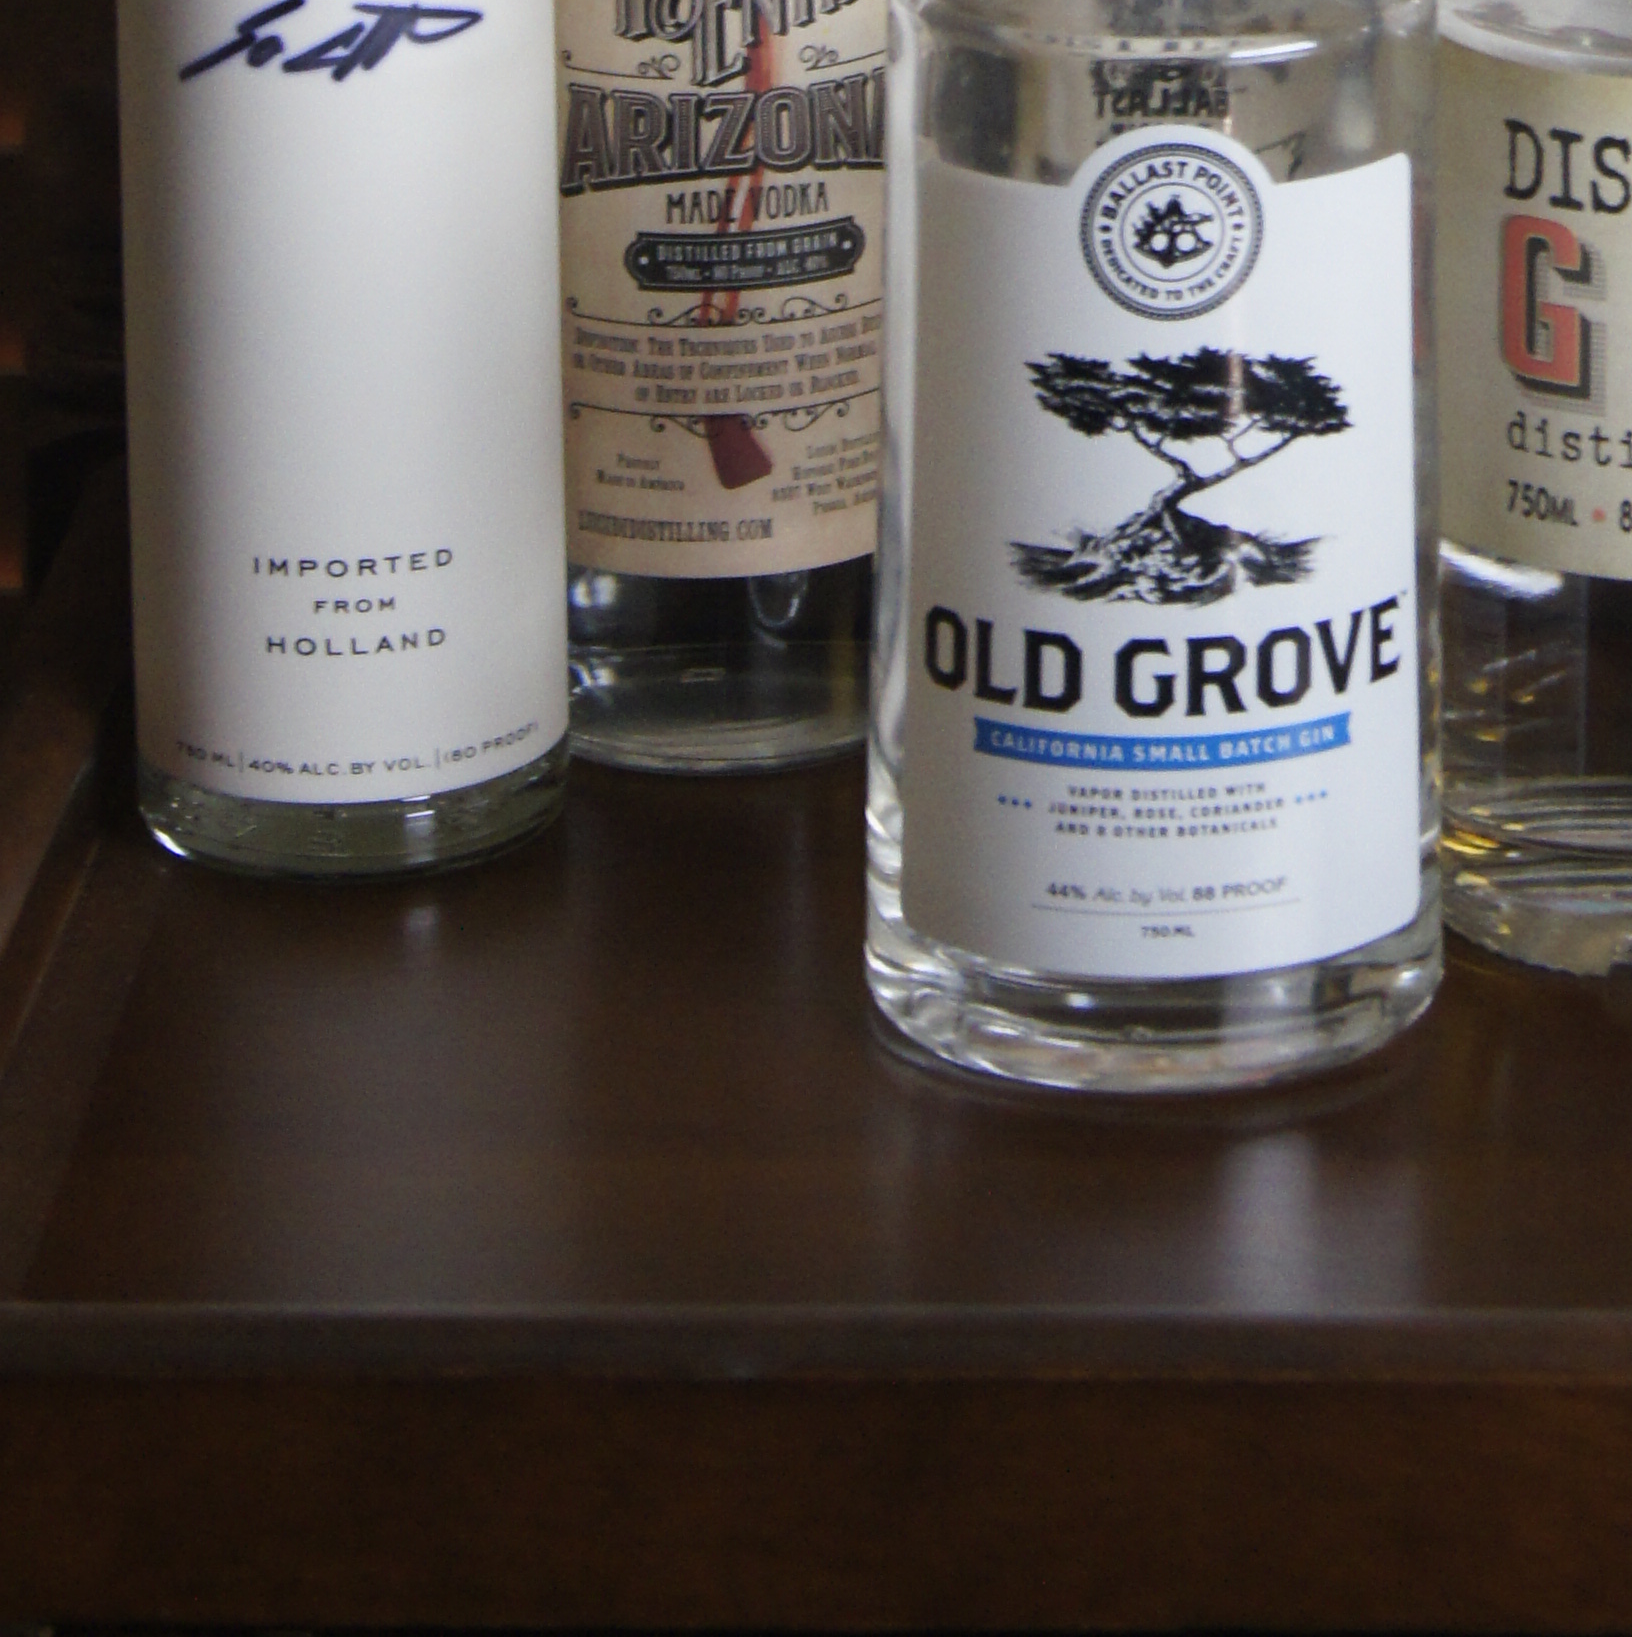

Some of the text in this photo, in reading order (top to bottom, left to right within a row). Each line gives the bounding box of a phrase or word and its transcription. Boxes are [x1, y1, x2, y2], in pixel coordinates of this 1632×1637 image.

[752, 181, 829, 222] VODKA
[1101, 160, 1245, 221] BALLAST POINT
[252, 548, 454, 579] IMPORTED
[313, 596, 397, 615] FROM
[266, 627, 449, 657] HOLLAND
[924, 593, 1403, 718] OLD GROVE
[990, 724, 1336, 763] CALIFORNIA SMALL BATCH GIN
